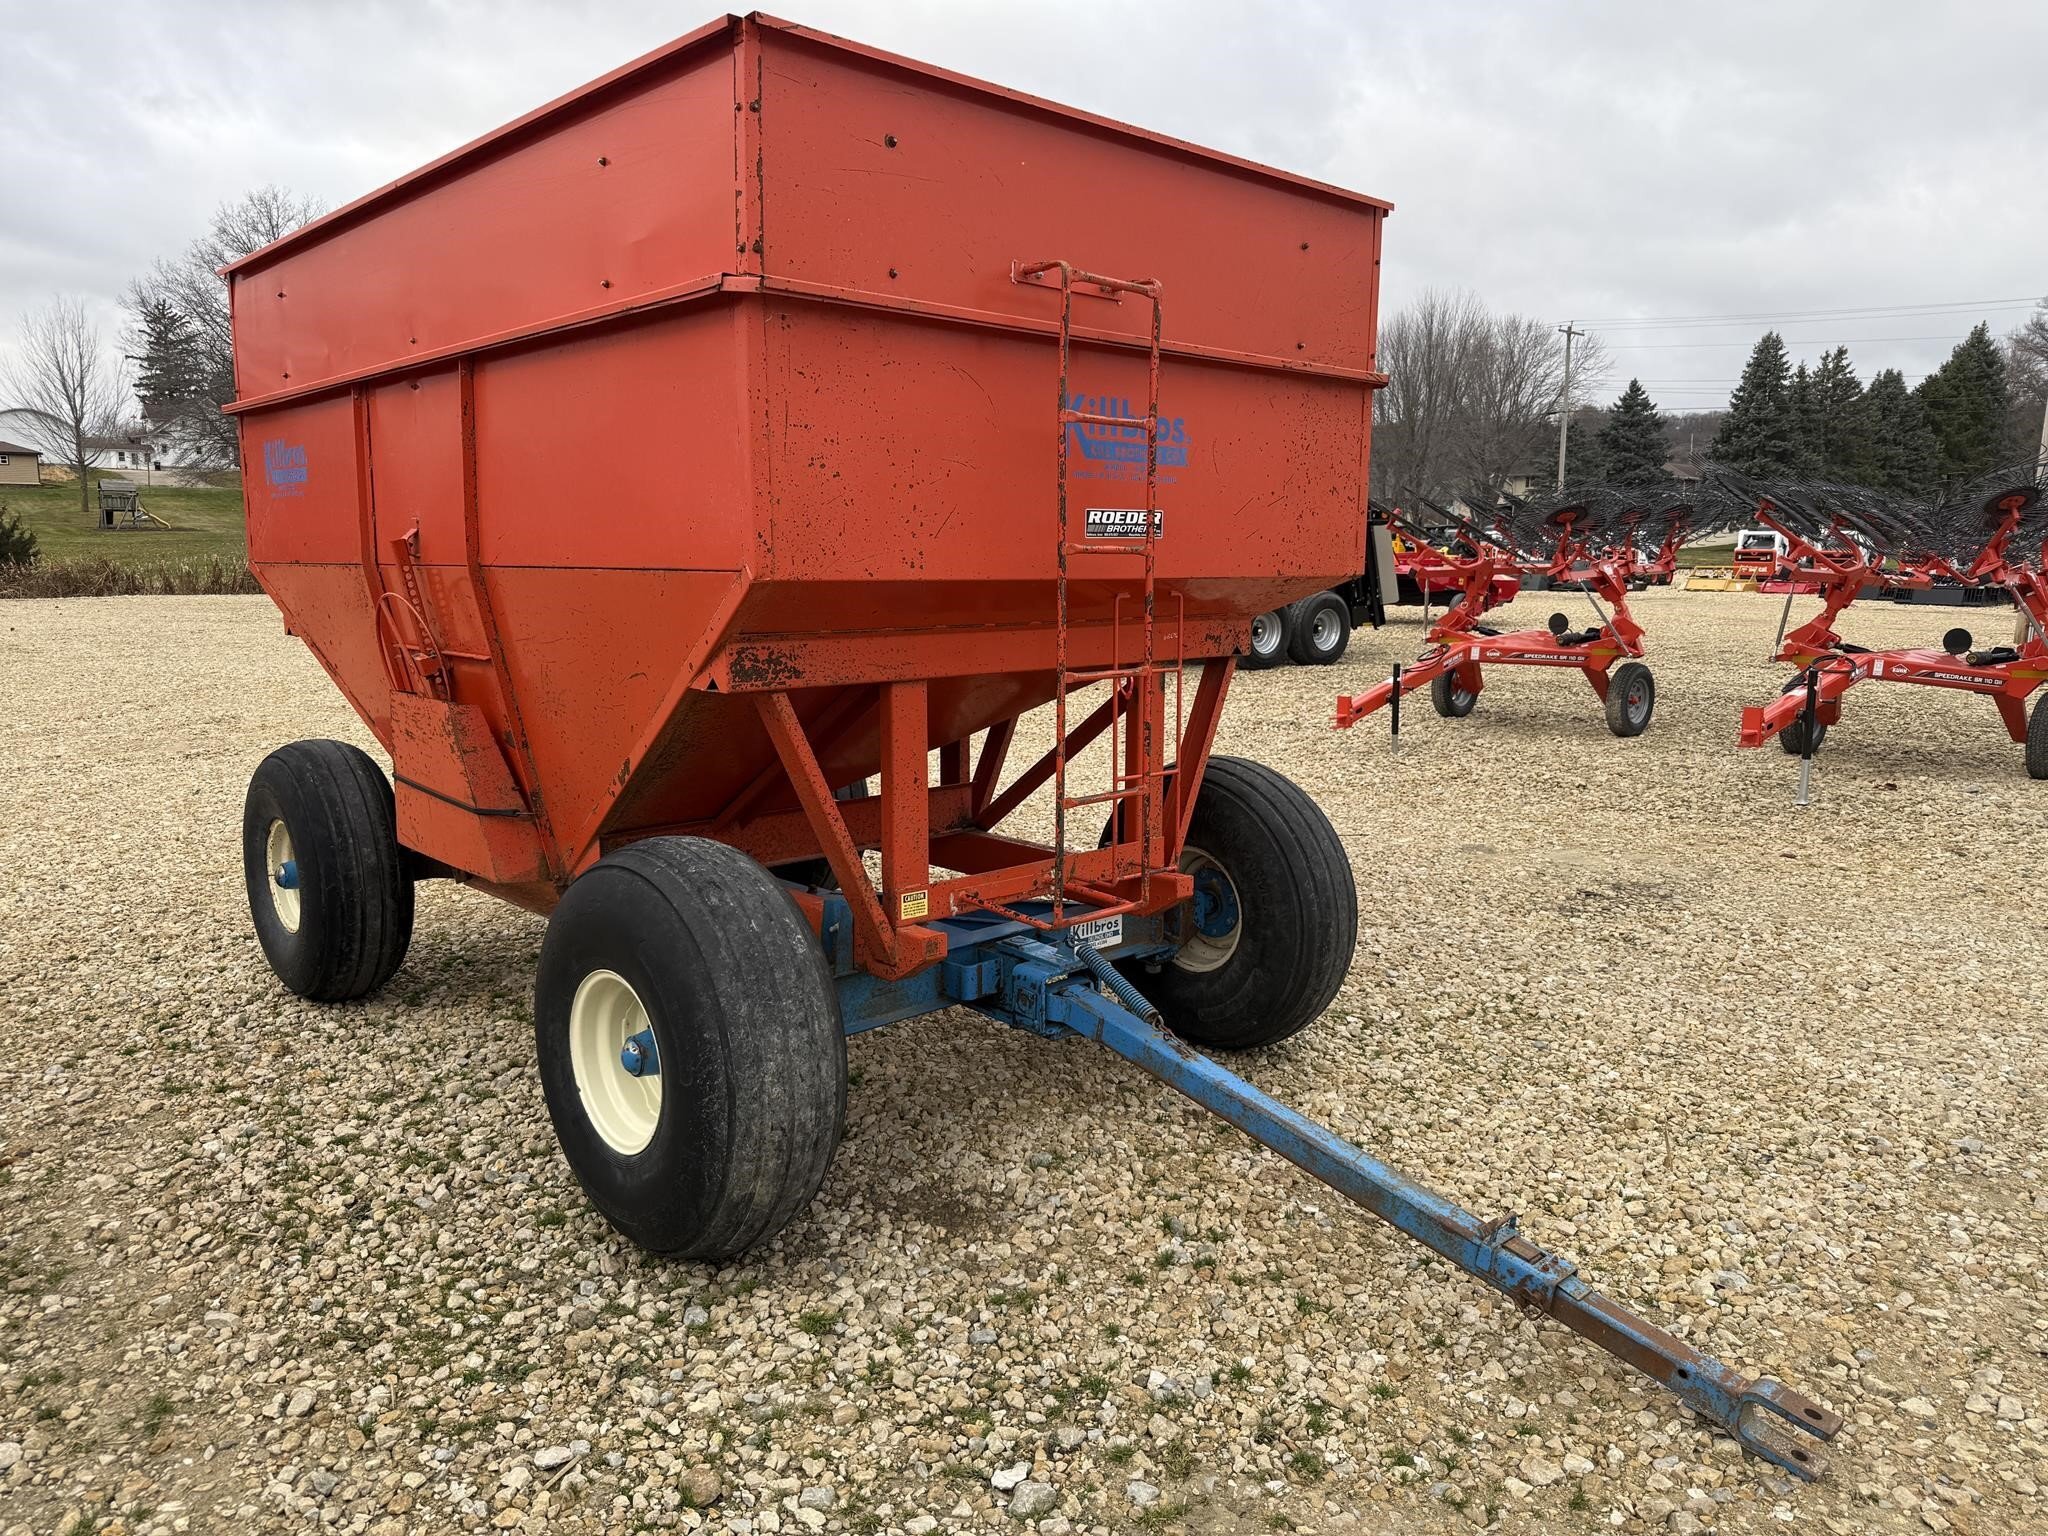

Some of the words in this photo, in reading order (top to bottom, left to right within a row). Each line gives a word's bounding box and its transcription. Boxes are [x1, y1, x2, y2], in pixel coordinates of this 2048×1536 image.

[1088, 511, 1162, 524] ROEDER
[1106, 524, 1157, 533] BROTHE
[1934, 672, 1973, 682] SPEEDRAKE
[904, 892, 925, 902] CAUTION
[1072, 919, 1119, 942] Killbros
